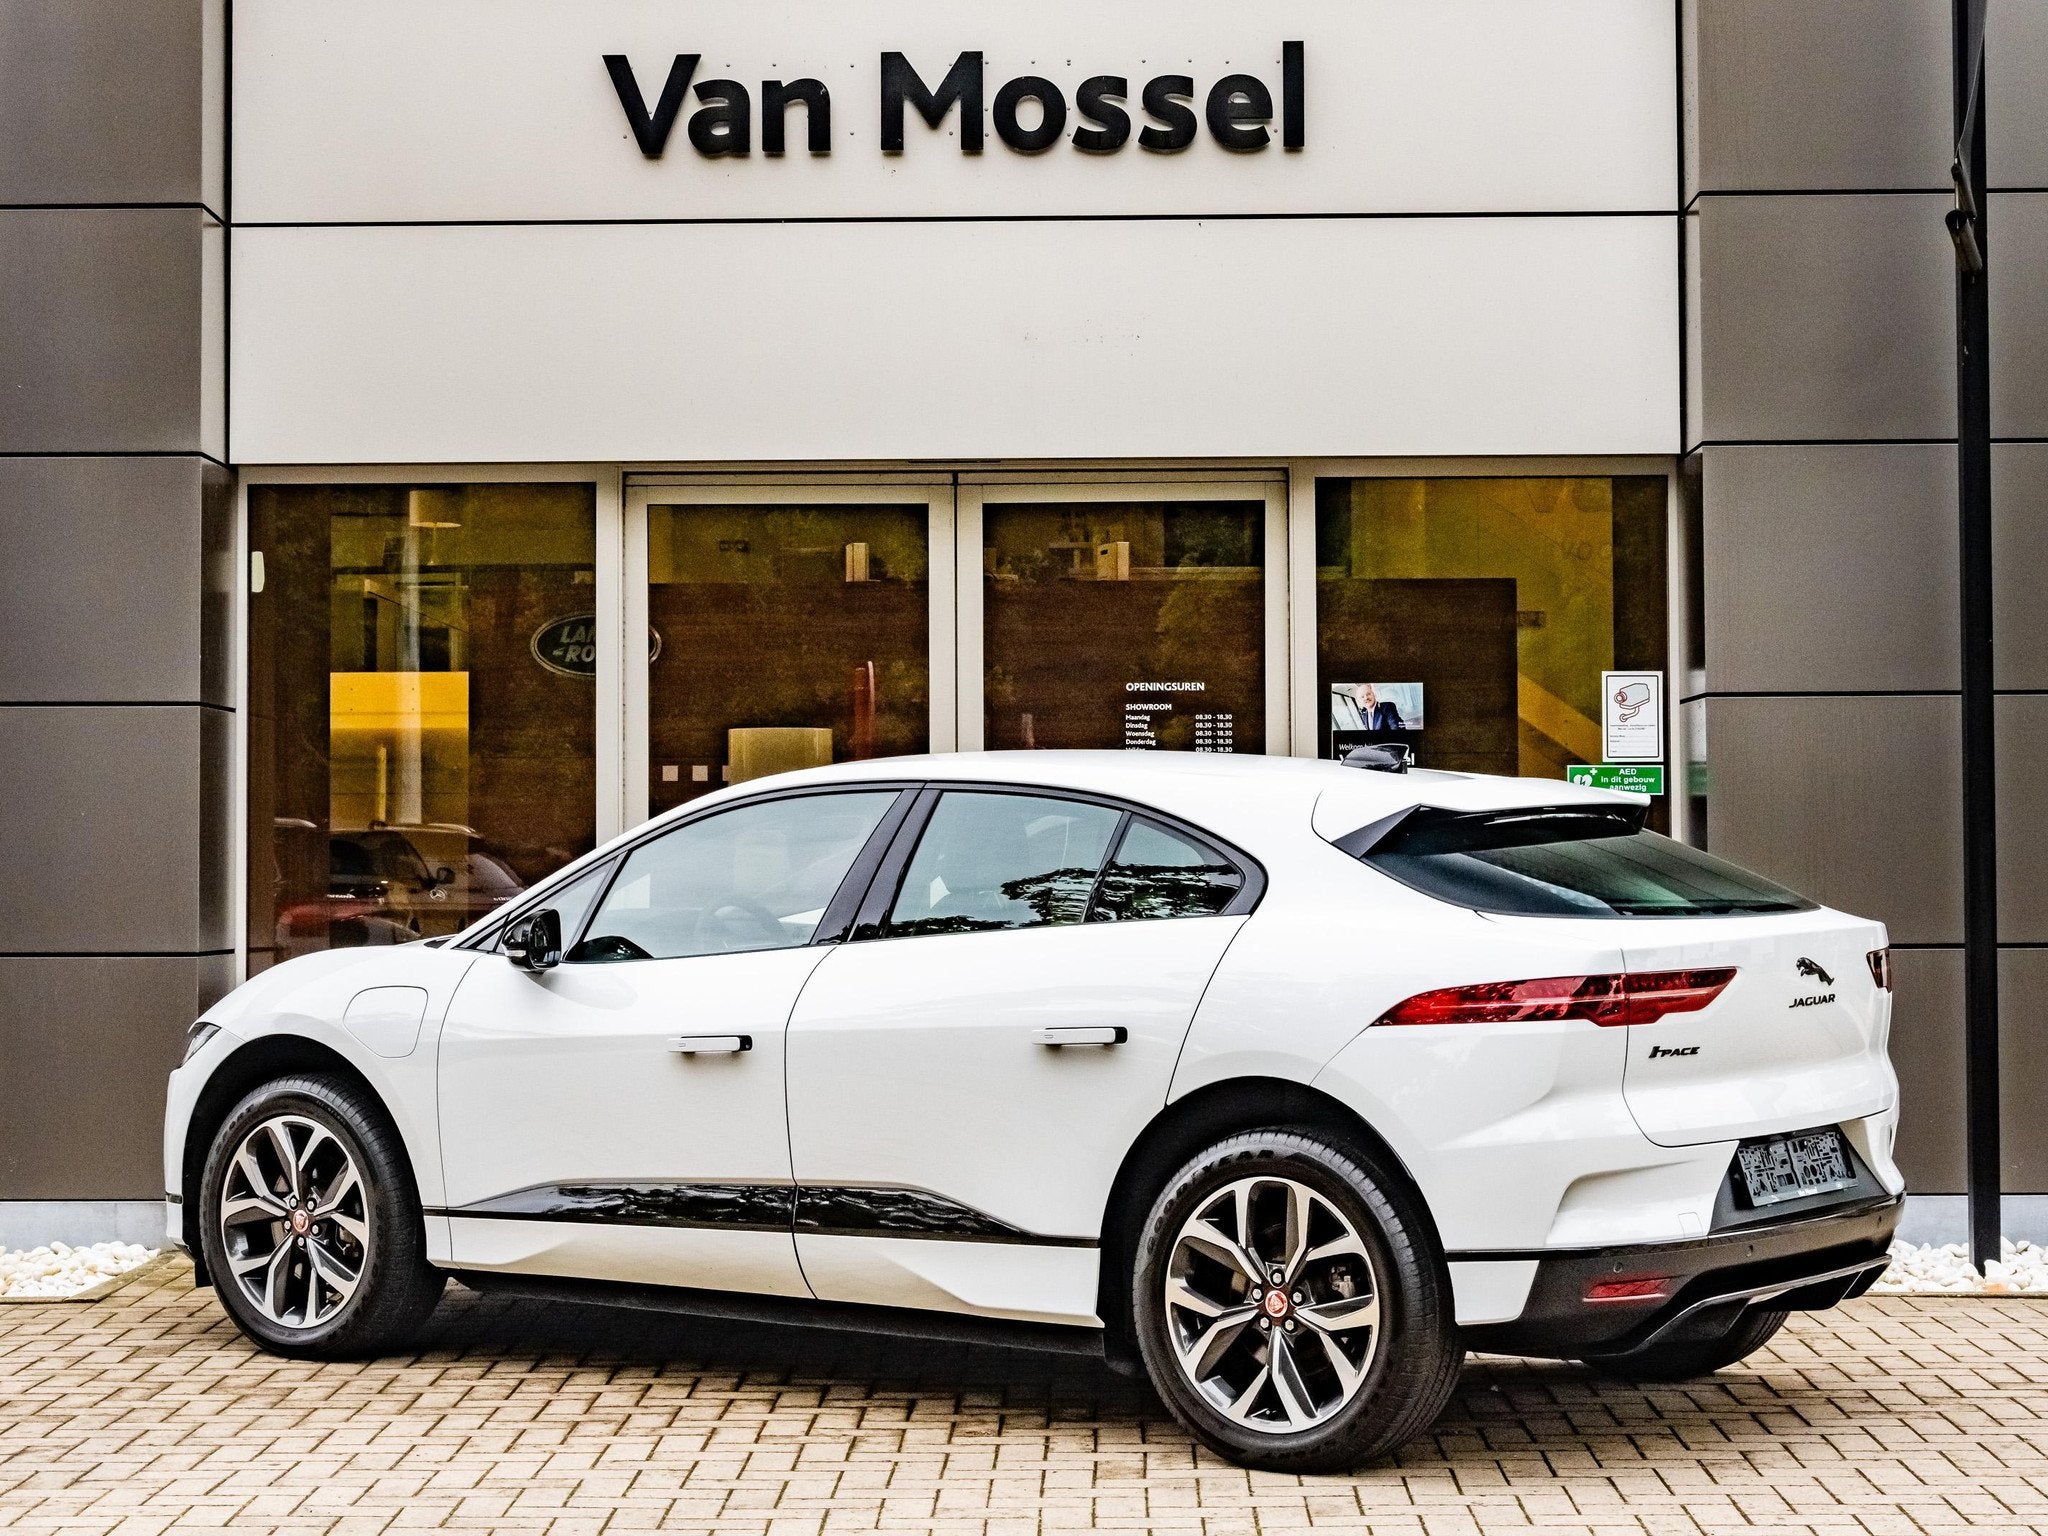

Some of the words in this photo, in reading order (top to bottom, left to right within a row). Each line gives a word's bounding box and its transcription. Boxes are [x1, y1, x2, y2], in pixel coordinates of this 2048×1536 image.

[602, 54, 831, 160] Van
[881, 41, 1304, 158] Mossel
[1125, 682, 1205, 692] OPENINGSUREN
[1125, 703, 1172, 711] SHOWROOM
[1125, 730, 1155, 738] Woensdag
[1125, 738, 1156, 746] Donderdag
[1623, 776, 1655, 785] gebouw
[1609, 784, 1647, 792] aanwezig
[1789, 993, 1836, 1009] JAGUAR
